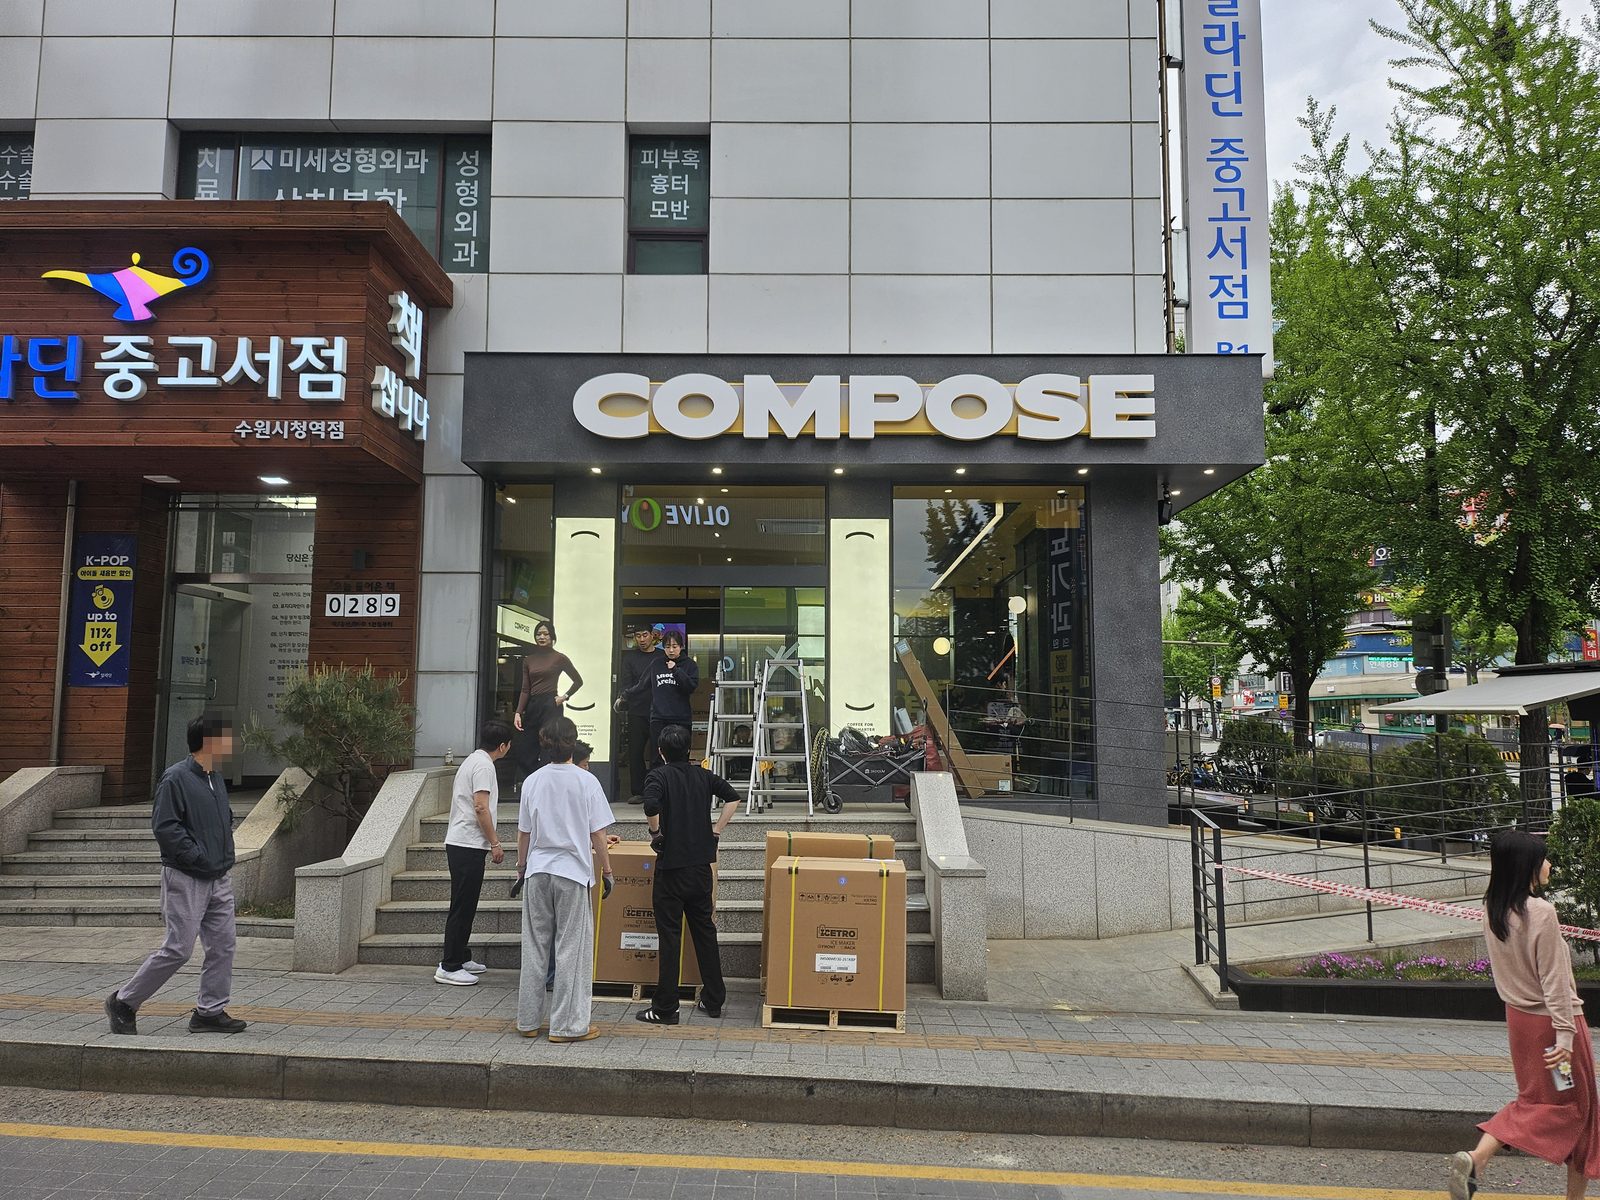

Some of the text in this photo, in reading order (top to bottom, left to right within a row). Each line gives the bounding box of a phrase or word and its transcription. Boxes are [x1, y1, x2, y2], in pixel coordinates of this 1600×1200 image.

[280, 148, 429, 174] 미세성형외과
[640, 148, 701, 169] 피부혹
[650, 173, 689, 195] 흉터
[452, 151, 479, 267] 성형외과
[650, 199, 690, 220] 모반
[1206, 138, 1251, 320] 중고서점
[387, 290, 423, 381] 책
[94, 335, 347, 402] 중고서점
[371, 364, 430, 442] 삽니다
[573, 372, 1157, 441] COMPOSE
[234, 420, 345, 440] 수원시청역점
[86, 555, 129, 566] K-POP
[286, 553, 309, 562] 당신은
[329, 597, 396, 614] 0289
[87, 611, 117, 622] up to
[90, 627, 112, 638] 11%
[89, 641, 111, 652] off
[820, 928, 856, 938] ICETRO
